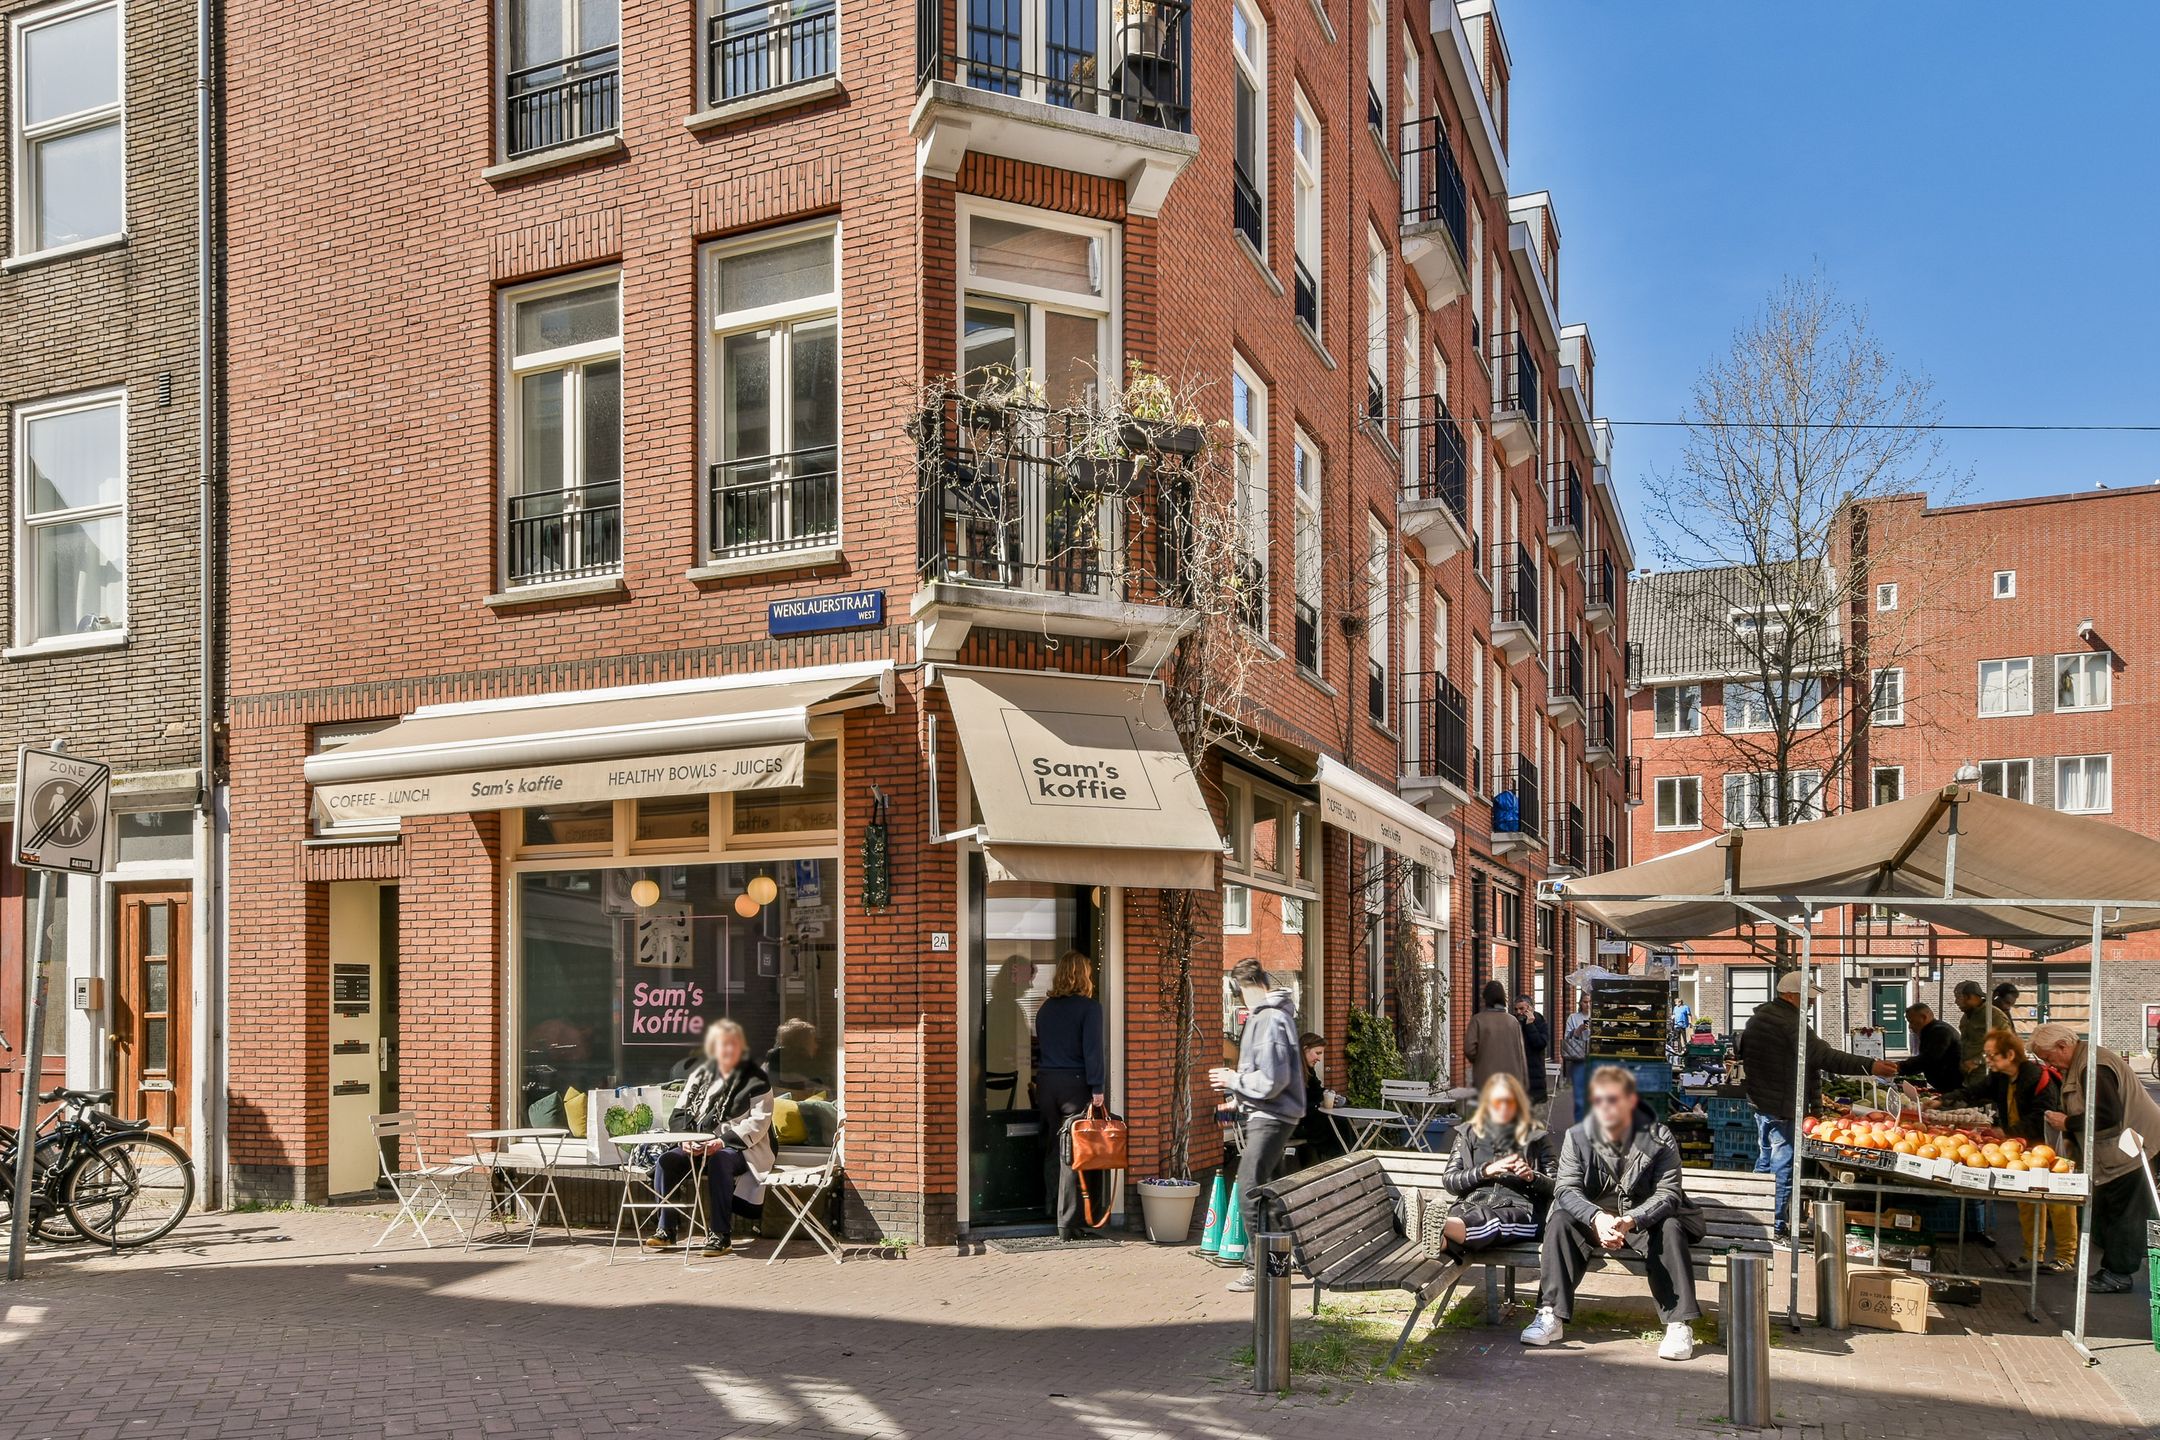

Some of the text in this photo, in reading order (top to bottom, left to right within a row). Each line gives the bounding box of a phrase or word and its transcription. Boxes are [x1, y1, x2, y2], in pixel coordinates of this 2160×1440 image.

[773, 594, 875, 618] WENSLAUERSTRAAT
[858, 610, 876, 620] WEST
[50, 760, 86, 777] ZONE
[1031, 757, 1120, 779] Sam's
[329, 793, 376, 808] COFFEE
[388, 788, 430, 804] LUNCH
[471, 780, 513, 797] Sam's
[517, 775, 563, 793] koffie
[608, 768, 665, 786] HEALTHY
[669, 763, 717, 781] BOWLS
[732, 757, 783, 776] JUICES
[1038, 778, 1127, 800] koffie
[933, 936, 948, 948] 2A
[632, 982, 704, 1007] Sam's
[632, 1008, 704, 1034] koffie
